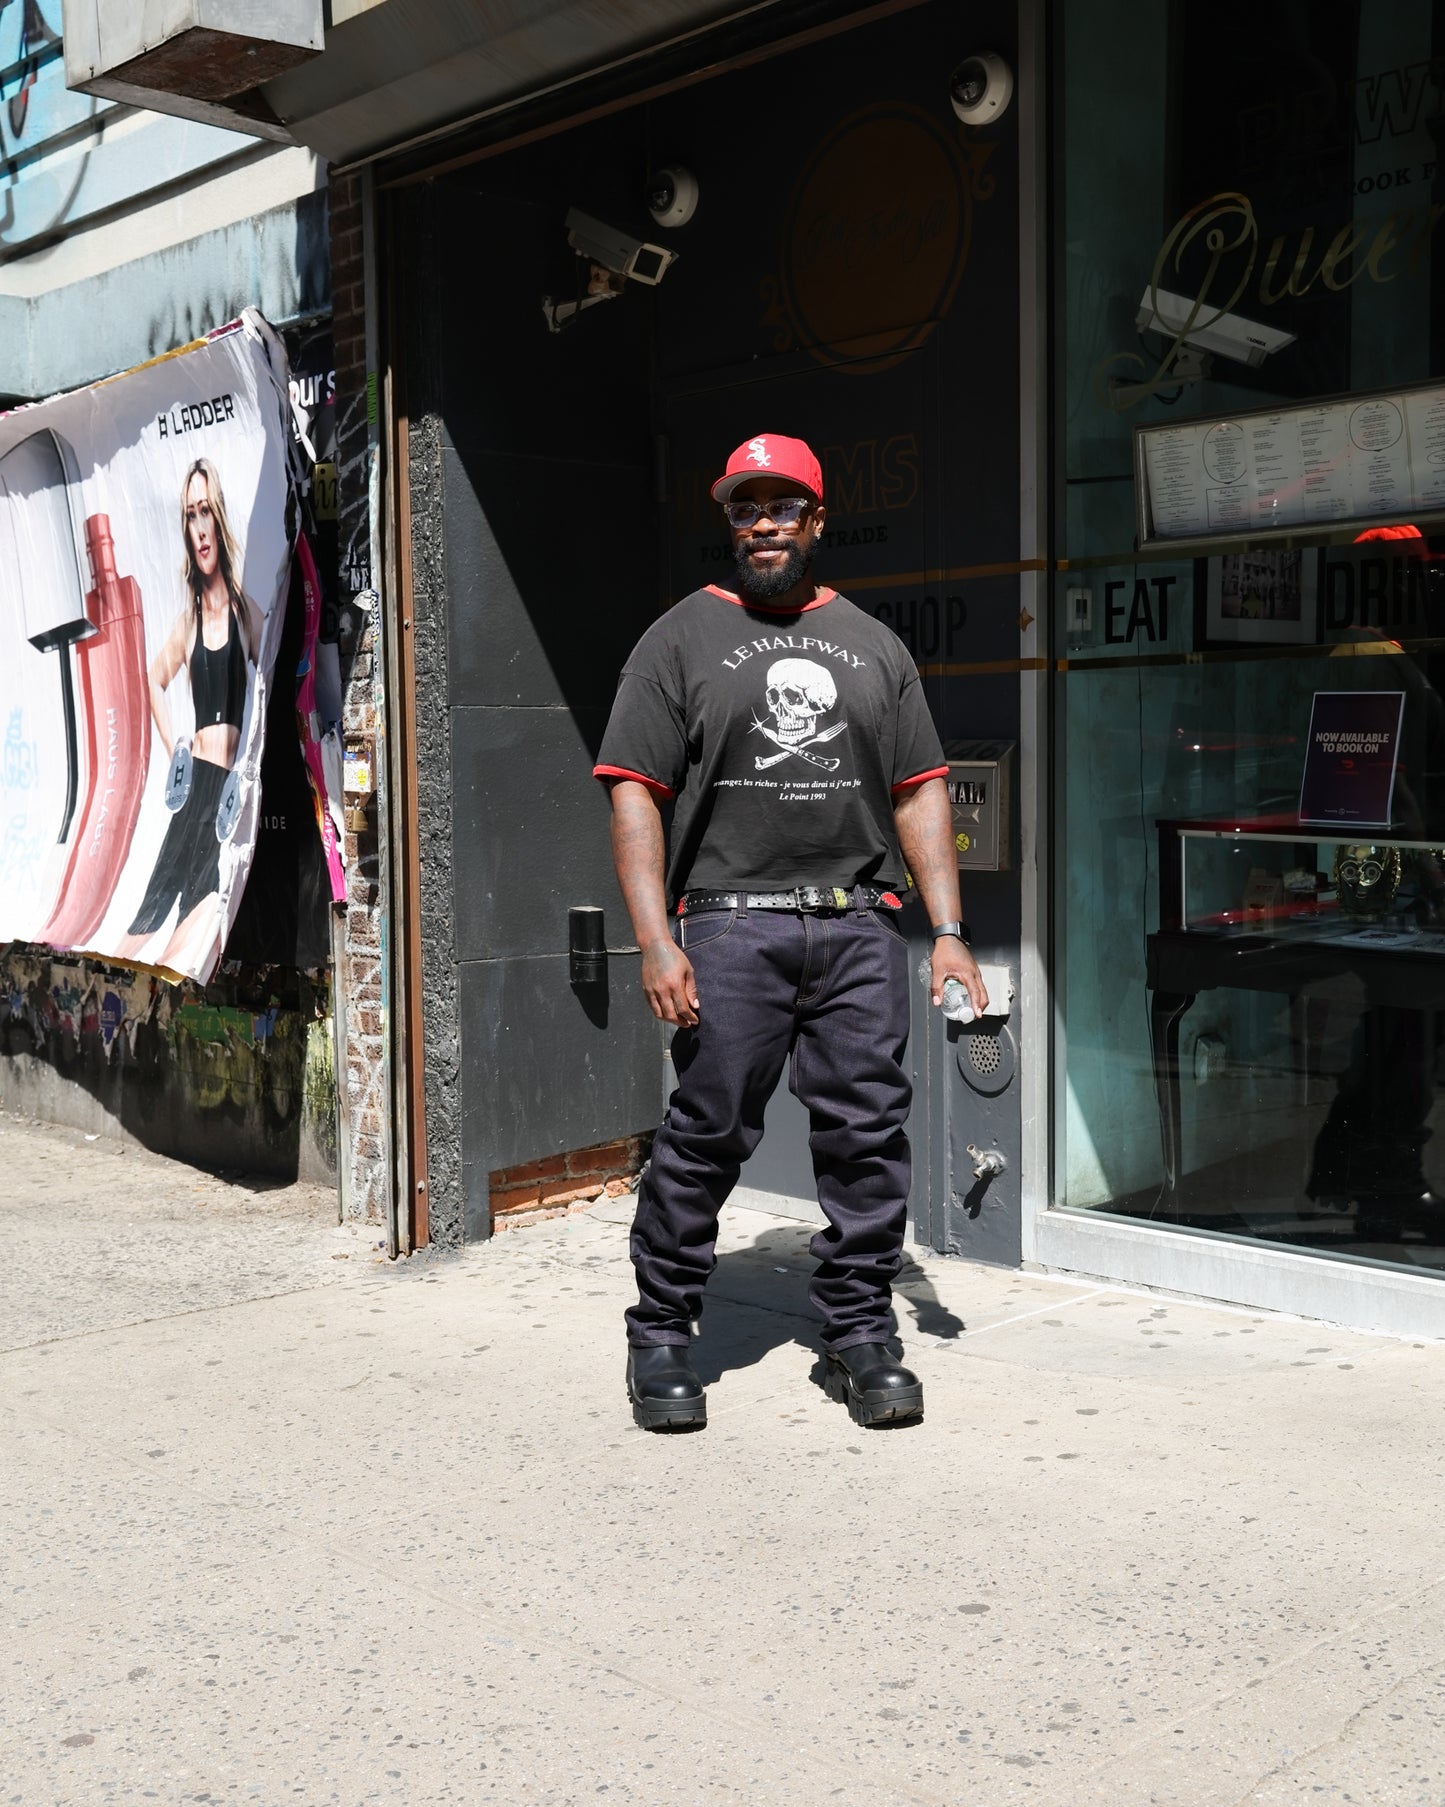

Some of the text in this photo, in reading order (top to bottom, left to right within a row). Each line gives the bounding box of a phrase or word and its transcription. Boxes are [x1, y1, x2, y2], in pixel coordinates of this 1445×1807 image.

[172, 394, 234, 435] LADDER
[824, 524, 889, 548] TRADE
[1105, 576, 1176, 643] EAT
[722, 636, 866, 670] LE HALFWAY
[106, 707, 119, 780] HAUS
[1315, 732, 1390, 743] NOW AVAILABLE
[1322, 743, 1379, 753] TO BOOK ON
[743, 778, 753, 787] les
[754, 780, 778, 788] riches
[782, 780, 791, 790] je
[792, 781, 810, 789] vous
[811, 780, 828, 788] dirai
[829, 779, 835, 788] si
[946, 781, 986, 805] MAIL
[779, 792, 826, 801] Le Point 1993
[260, 815, 287, 830] IDE
